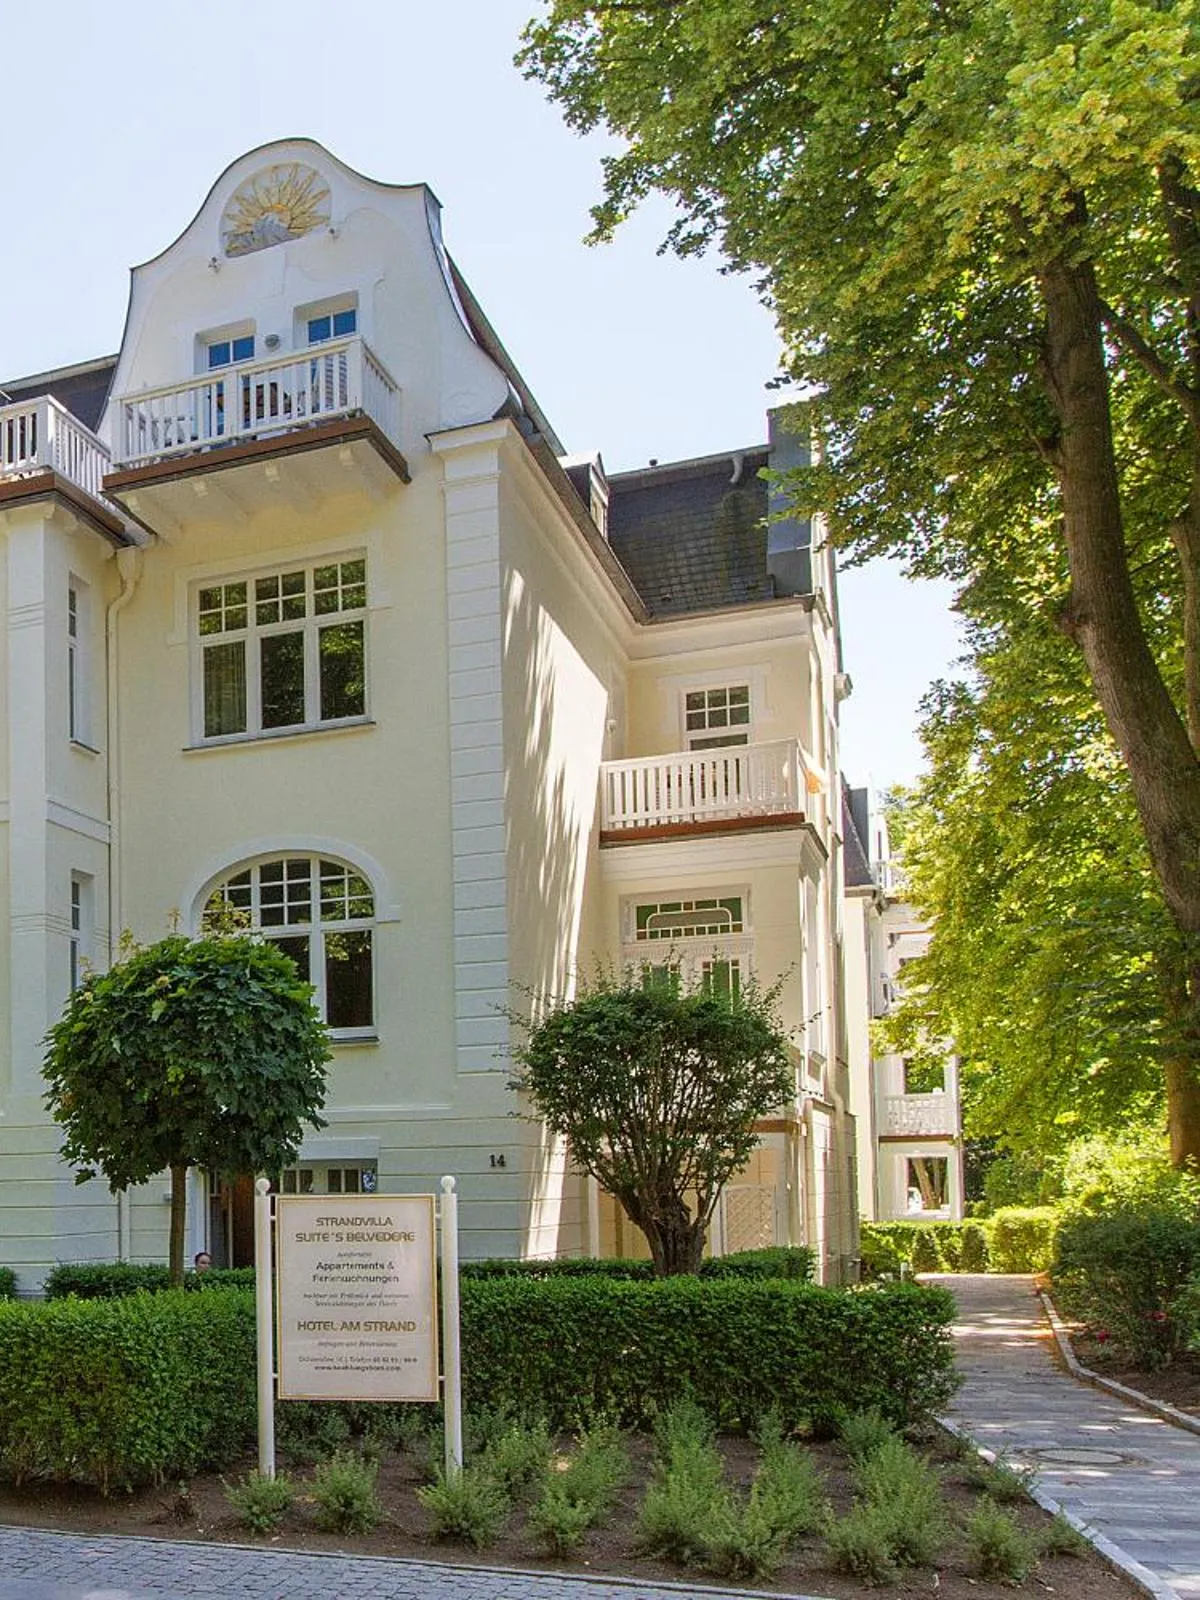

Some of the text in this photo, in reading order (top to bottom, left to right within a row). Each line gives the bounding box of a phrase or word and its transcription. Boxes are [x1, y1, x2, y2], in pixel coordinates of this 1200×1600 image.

[489, 1154, 506, 1168] 14
[315, 1216, 393, 1227] STRANDVILLA
[346, 1231, 416, 1242] BELVEDERE
[316, 1261, 395, 1271] Appartements &
[312, 1275, 400, 1284] Ferienwohnungen
[297, 1321, 417, 1332] HOTEL AM STRAND
